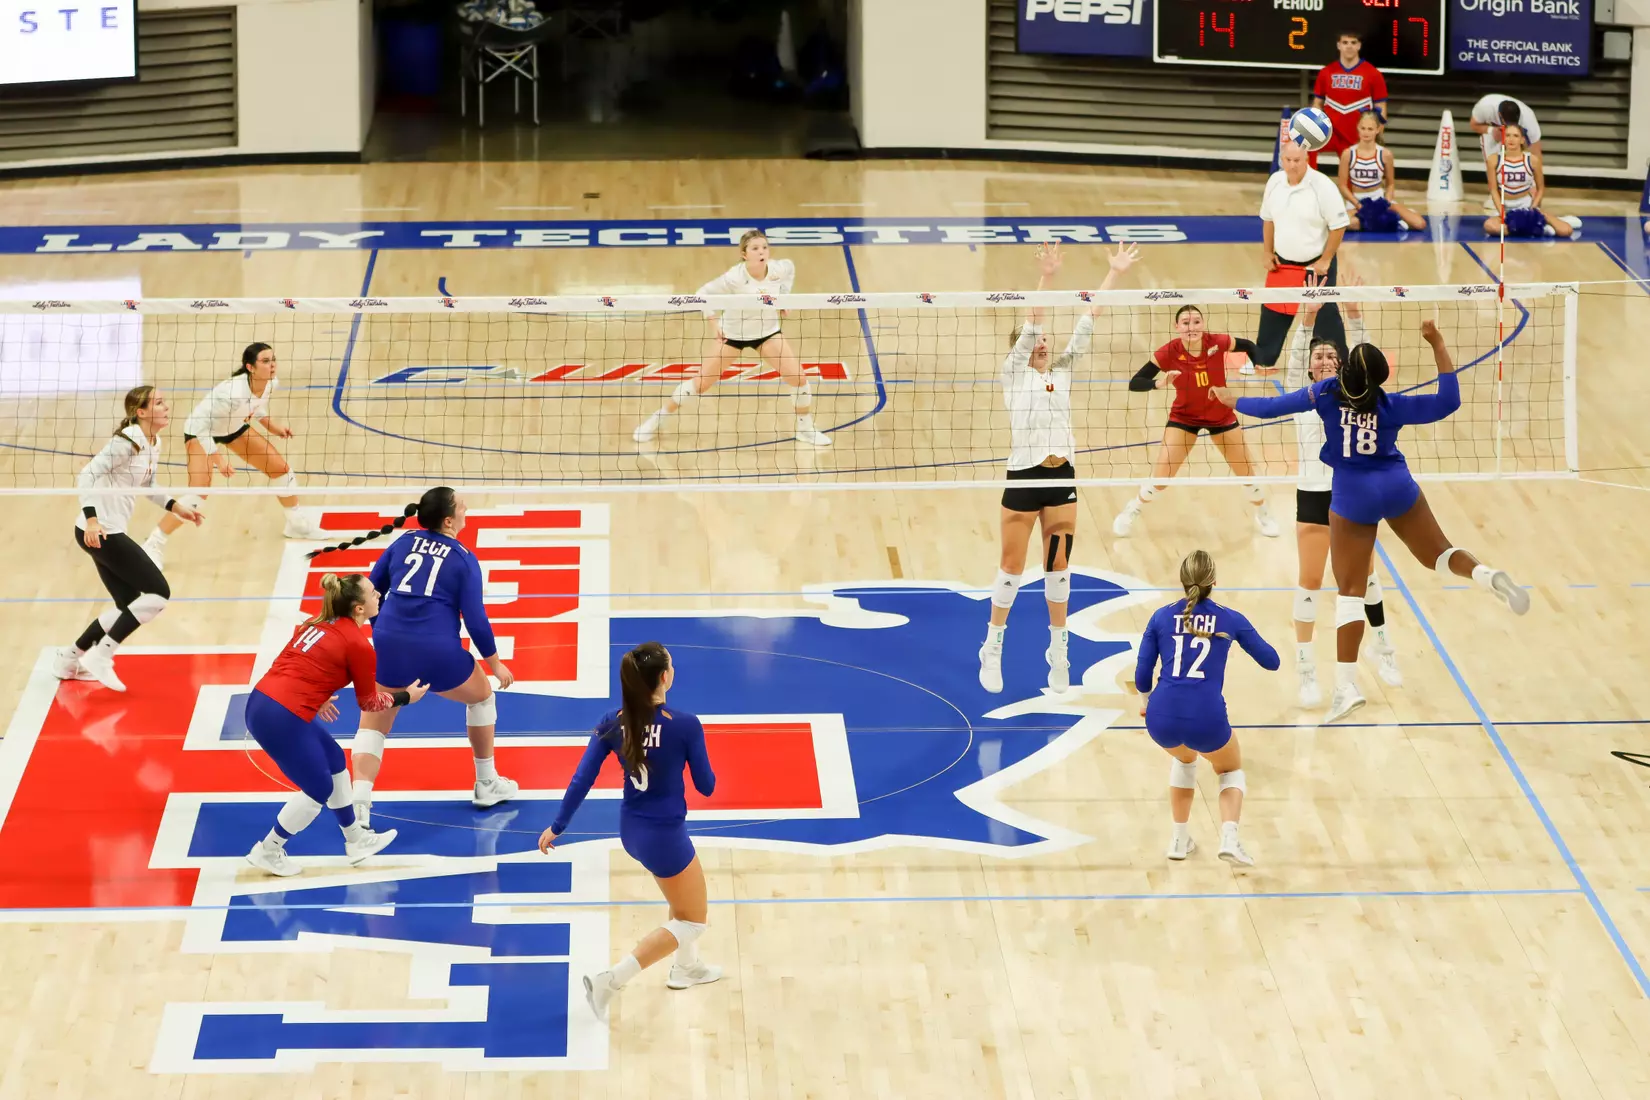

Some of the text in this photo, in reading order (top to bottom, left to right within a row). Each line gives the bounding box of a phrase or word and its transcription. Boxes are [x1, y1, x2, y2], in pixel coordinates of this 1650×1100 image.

[1026, 0, 1146, 25] PEPSI
[1274, 0, 1323, 11] PERIOD
[1460, 0, 1580, 17] Origin Bank
[1199, 12, 1235, 48] 14
[1289, 17, 1308, 50] 2
[1393, 17, 1429, 57] 17
[1467, 39, 1573, 53] THE OFFICIAL BANK
[1458, 52, 1581, 67] OF LA TECH ATHLETICS
[1331, 73, 1363, 90] TECH
[1440, 126, 1452, 191] LA TECH
[1354, 168, 1379, 180] TECH
[35, 224, 1188, 253] LADY TECHSTERS
[528, 363, 849, 382] USA
[1195, 371, 1209, 388] 10
[1339, 406, 1378, 430] TECH
[1340, 424, 1377, 458] 18
[411, 535, 452, 558] TECH
[396, 552, 444, 597] 21
[292, 625, 326, 653] 14
[1171, 635, 1211, 679] 12
[192, 861, 571, 1061] LA
